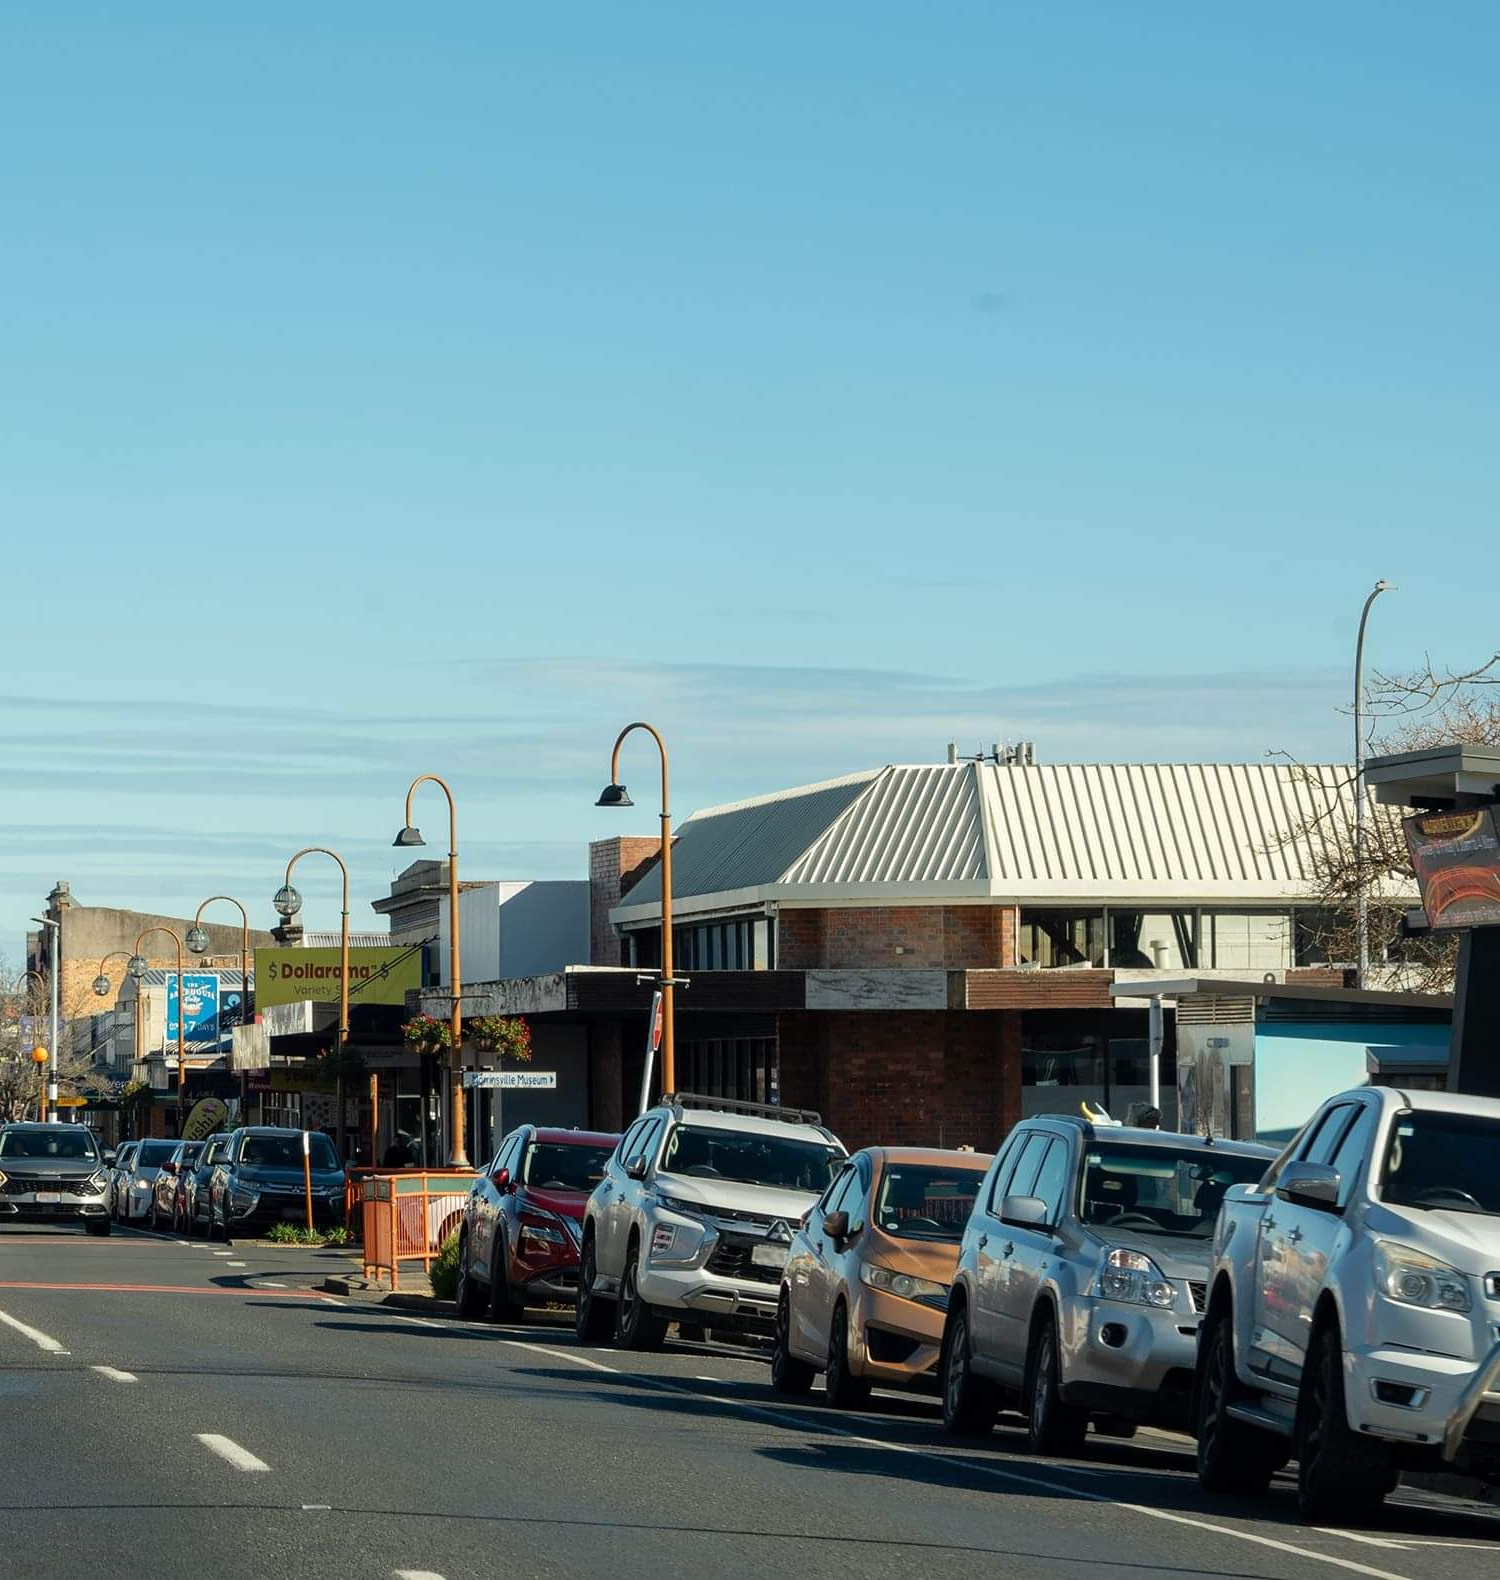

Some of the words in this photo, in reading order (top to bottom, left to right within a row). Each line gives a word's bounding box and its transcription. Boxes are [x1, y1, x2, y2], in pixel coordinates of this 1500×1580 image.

[293, 984, 333, 996] Variety
[187, 1020, 197, 1032] 7
[197, 1023, 215, 1031] DAYS
[472, 1074, 516, 1085] Morrinsville
[517, 1074, 548, 1085] Museum
[187, 1115, 215, 1141] ushi
